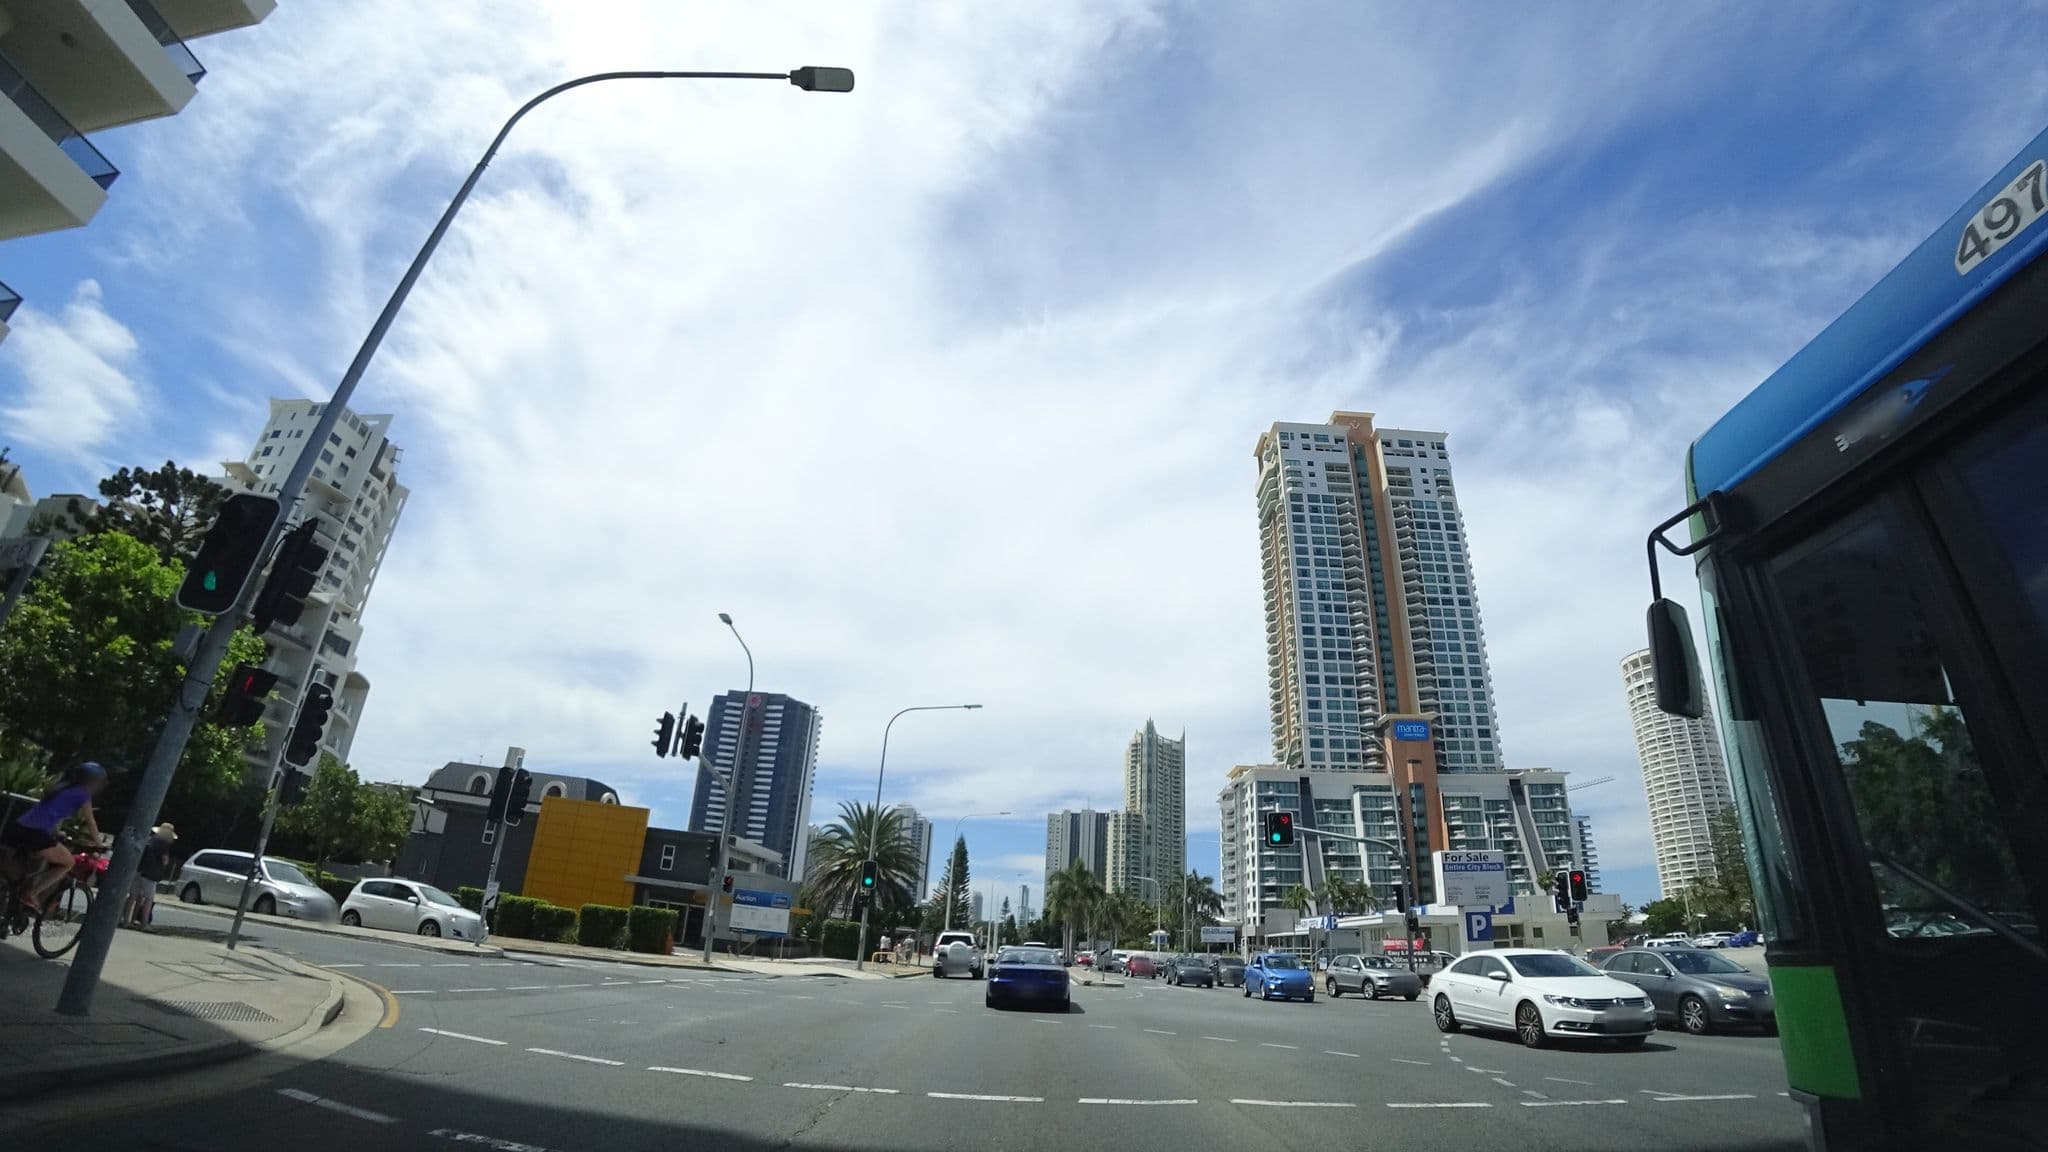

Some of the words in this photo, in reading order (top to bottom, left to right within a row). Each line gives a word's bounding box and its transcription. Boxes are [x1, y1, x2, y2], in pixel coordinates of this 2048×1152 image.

[1958, 163, 2045, 265] 497
[1397, 723, 1426, 733] mantra
[1444, 852, 1463, 862] For
[1466, 852, 1489, 862] Sale
[1445, 863, 1466, 871] Entire
[1466, 863, 1481, 872] City
[1482, 863, 1501, 871] Block
[735, 894, 757, 902] Auction
[1471, 914, 1487, 939] P
